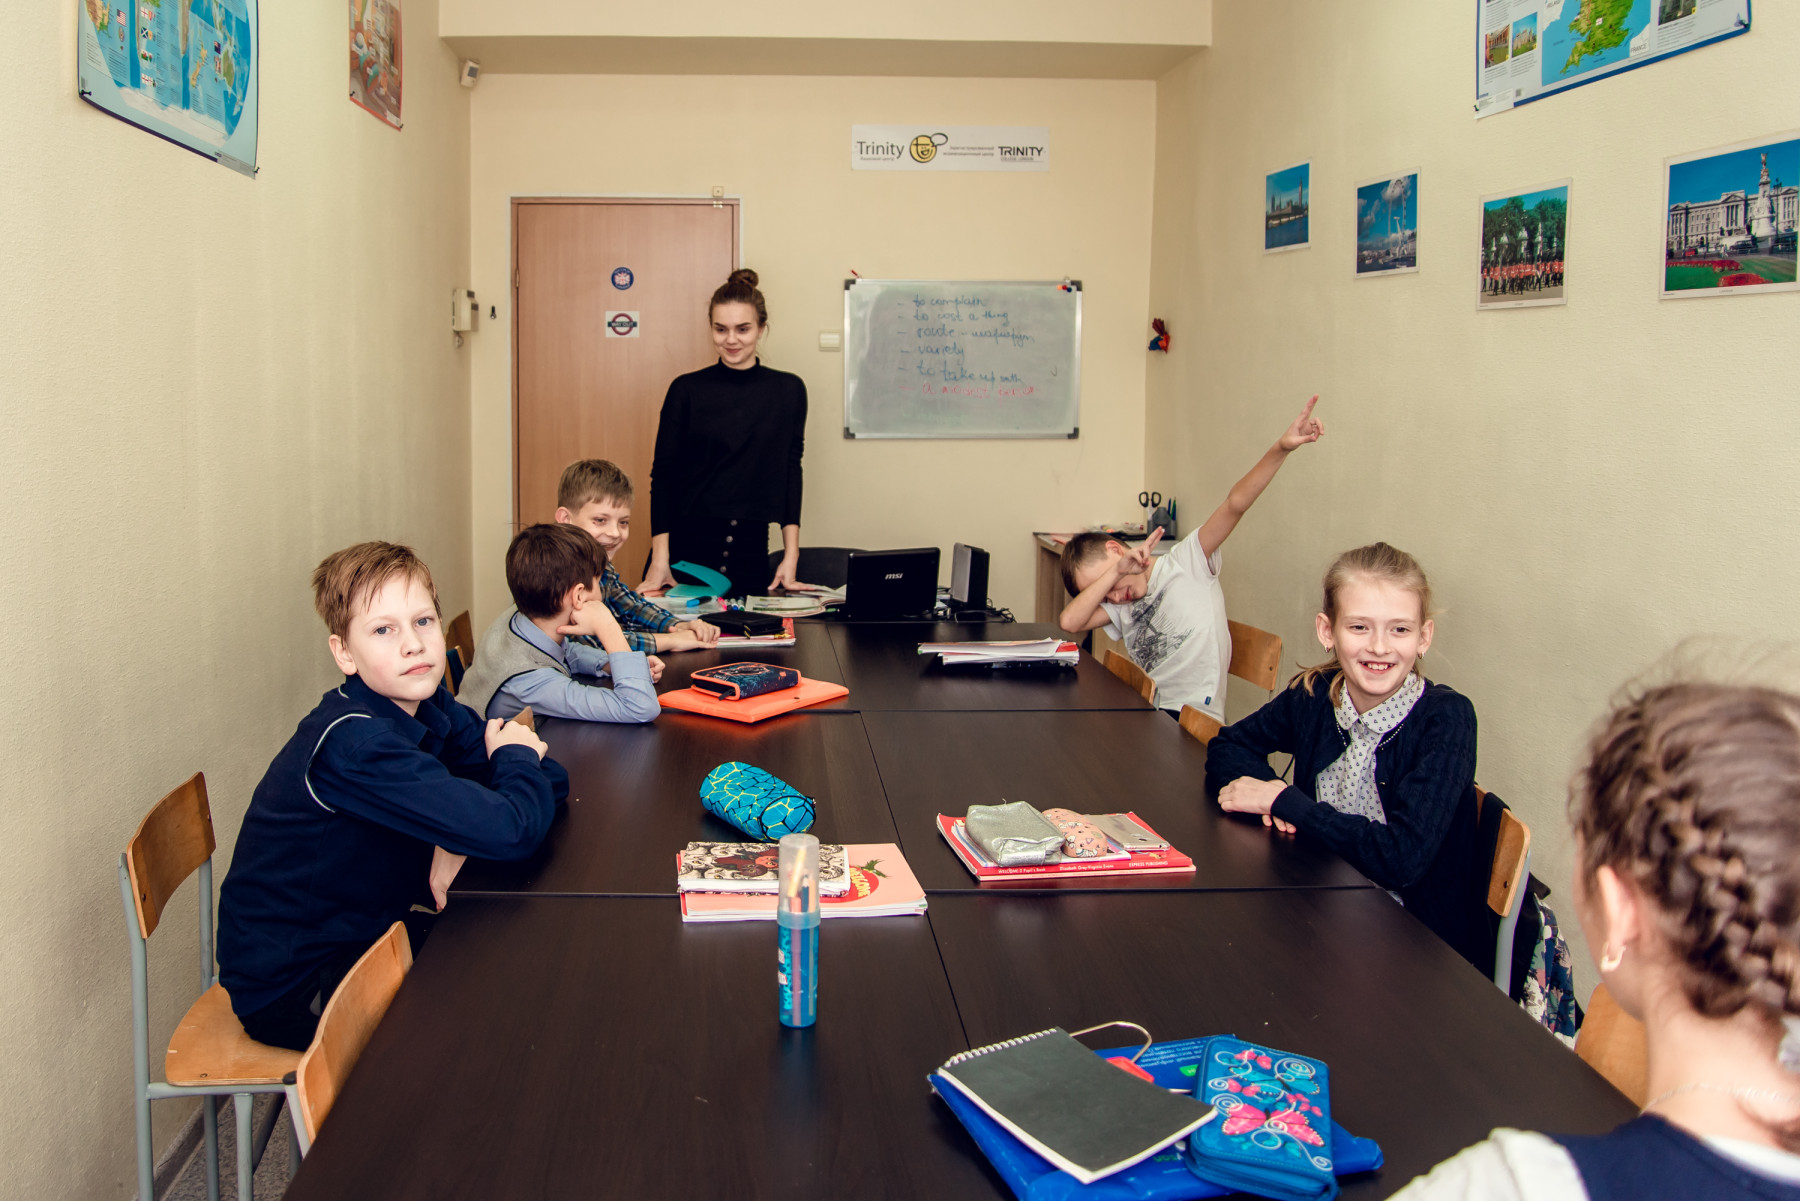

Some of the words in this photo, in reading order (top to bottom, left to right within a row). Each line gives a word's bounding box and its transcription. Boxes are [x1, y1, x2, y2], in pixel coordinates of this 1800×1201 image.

[1630, 43, 1647, 53] FRANCE
[856, 141, 905, 160] Trinity
[998, 146, 1044, 157] TRINITY
[912, 293, 926, 307] to
[913, 308, 929, 321] to
[918, 341, 965, 366] variety
[917, 360, 936, 376] to
[884, 572, 904, 580] msi
